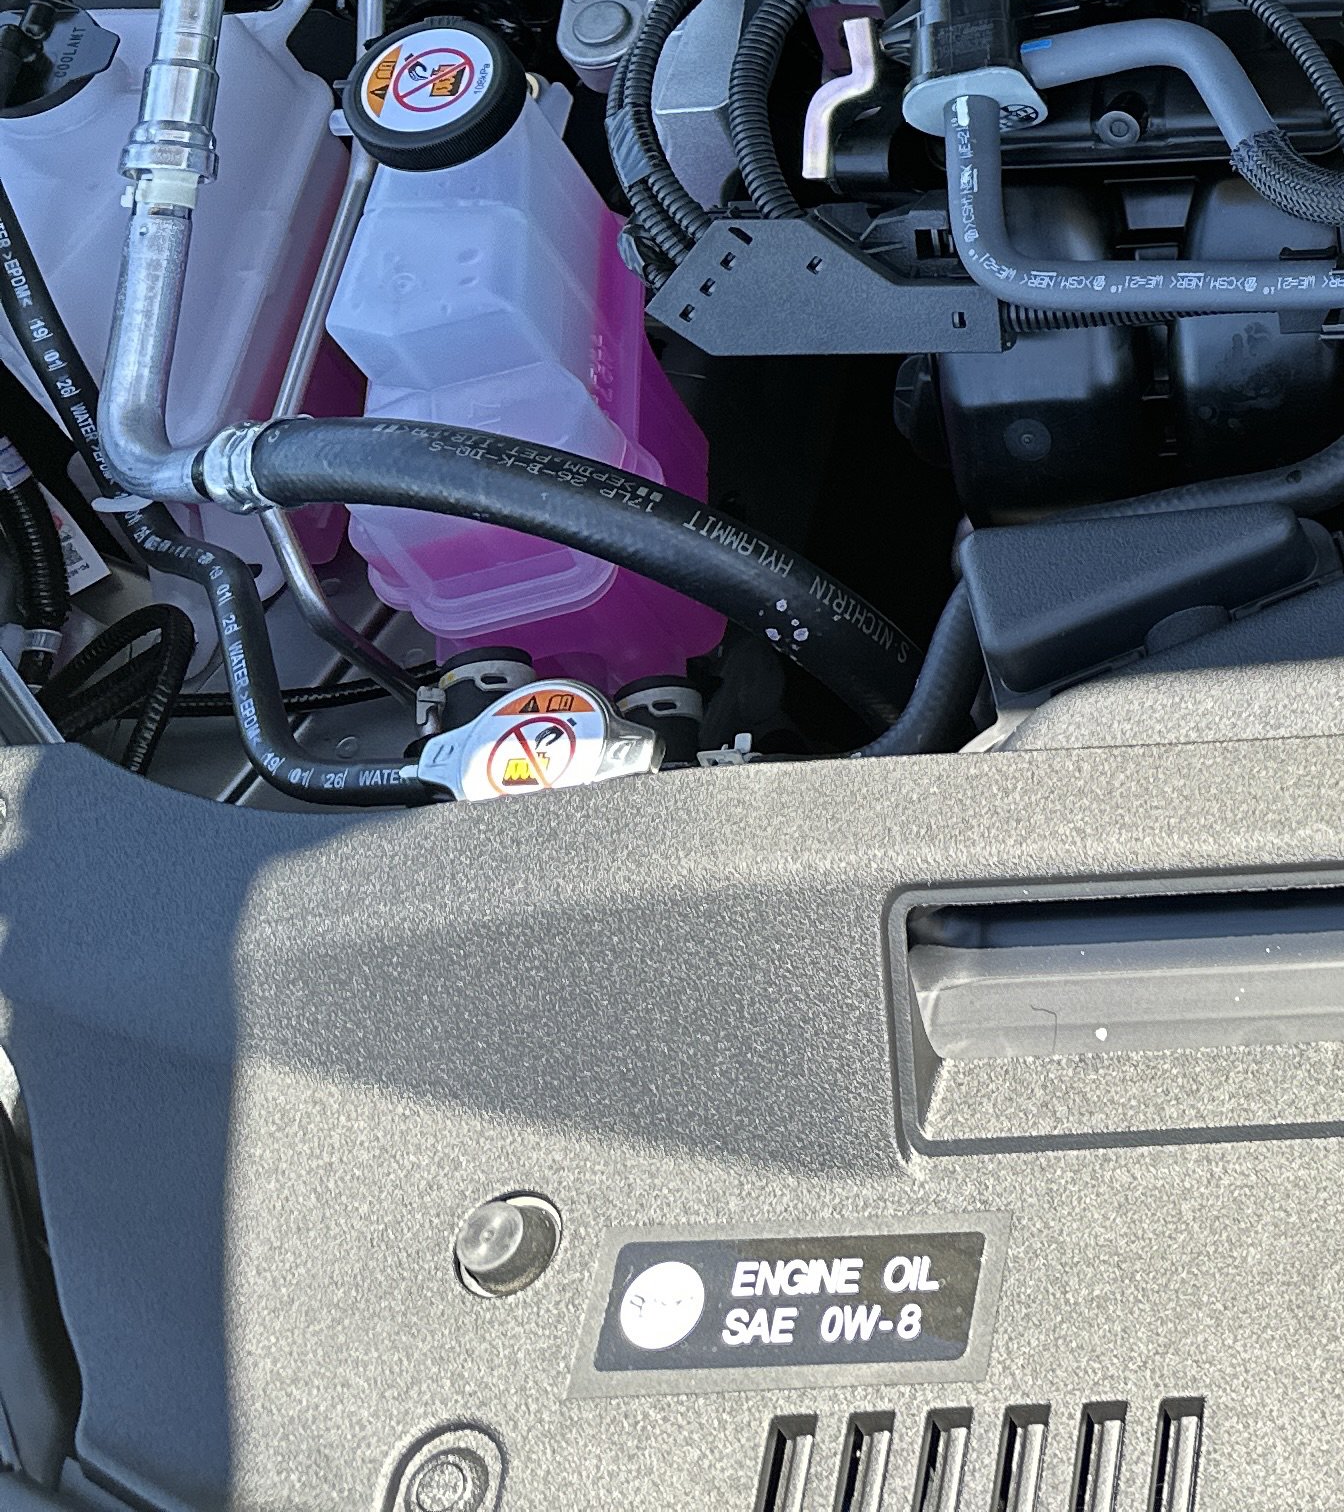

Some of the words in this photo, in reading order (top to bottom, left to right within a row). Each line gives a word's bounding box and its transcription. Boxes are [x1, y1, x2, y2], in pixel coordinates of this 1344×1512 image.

[55, 26, 87, 79] COOLANT
[474, 63, 491, 96] 108kPa
[682, 510, 795, 579] HYLAMMIT
[228, 639, 250, 691] WATER
[731, 1257, 864, 1297] ENGINE
[883, 1255, 940, 1292] OIL
[722, 1305, 799, 1346] SAE
[820, 1303, 923, 1343] 0W-8
